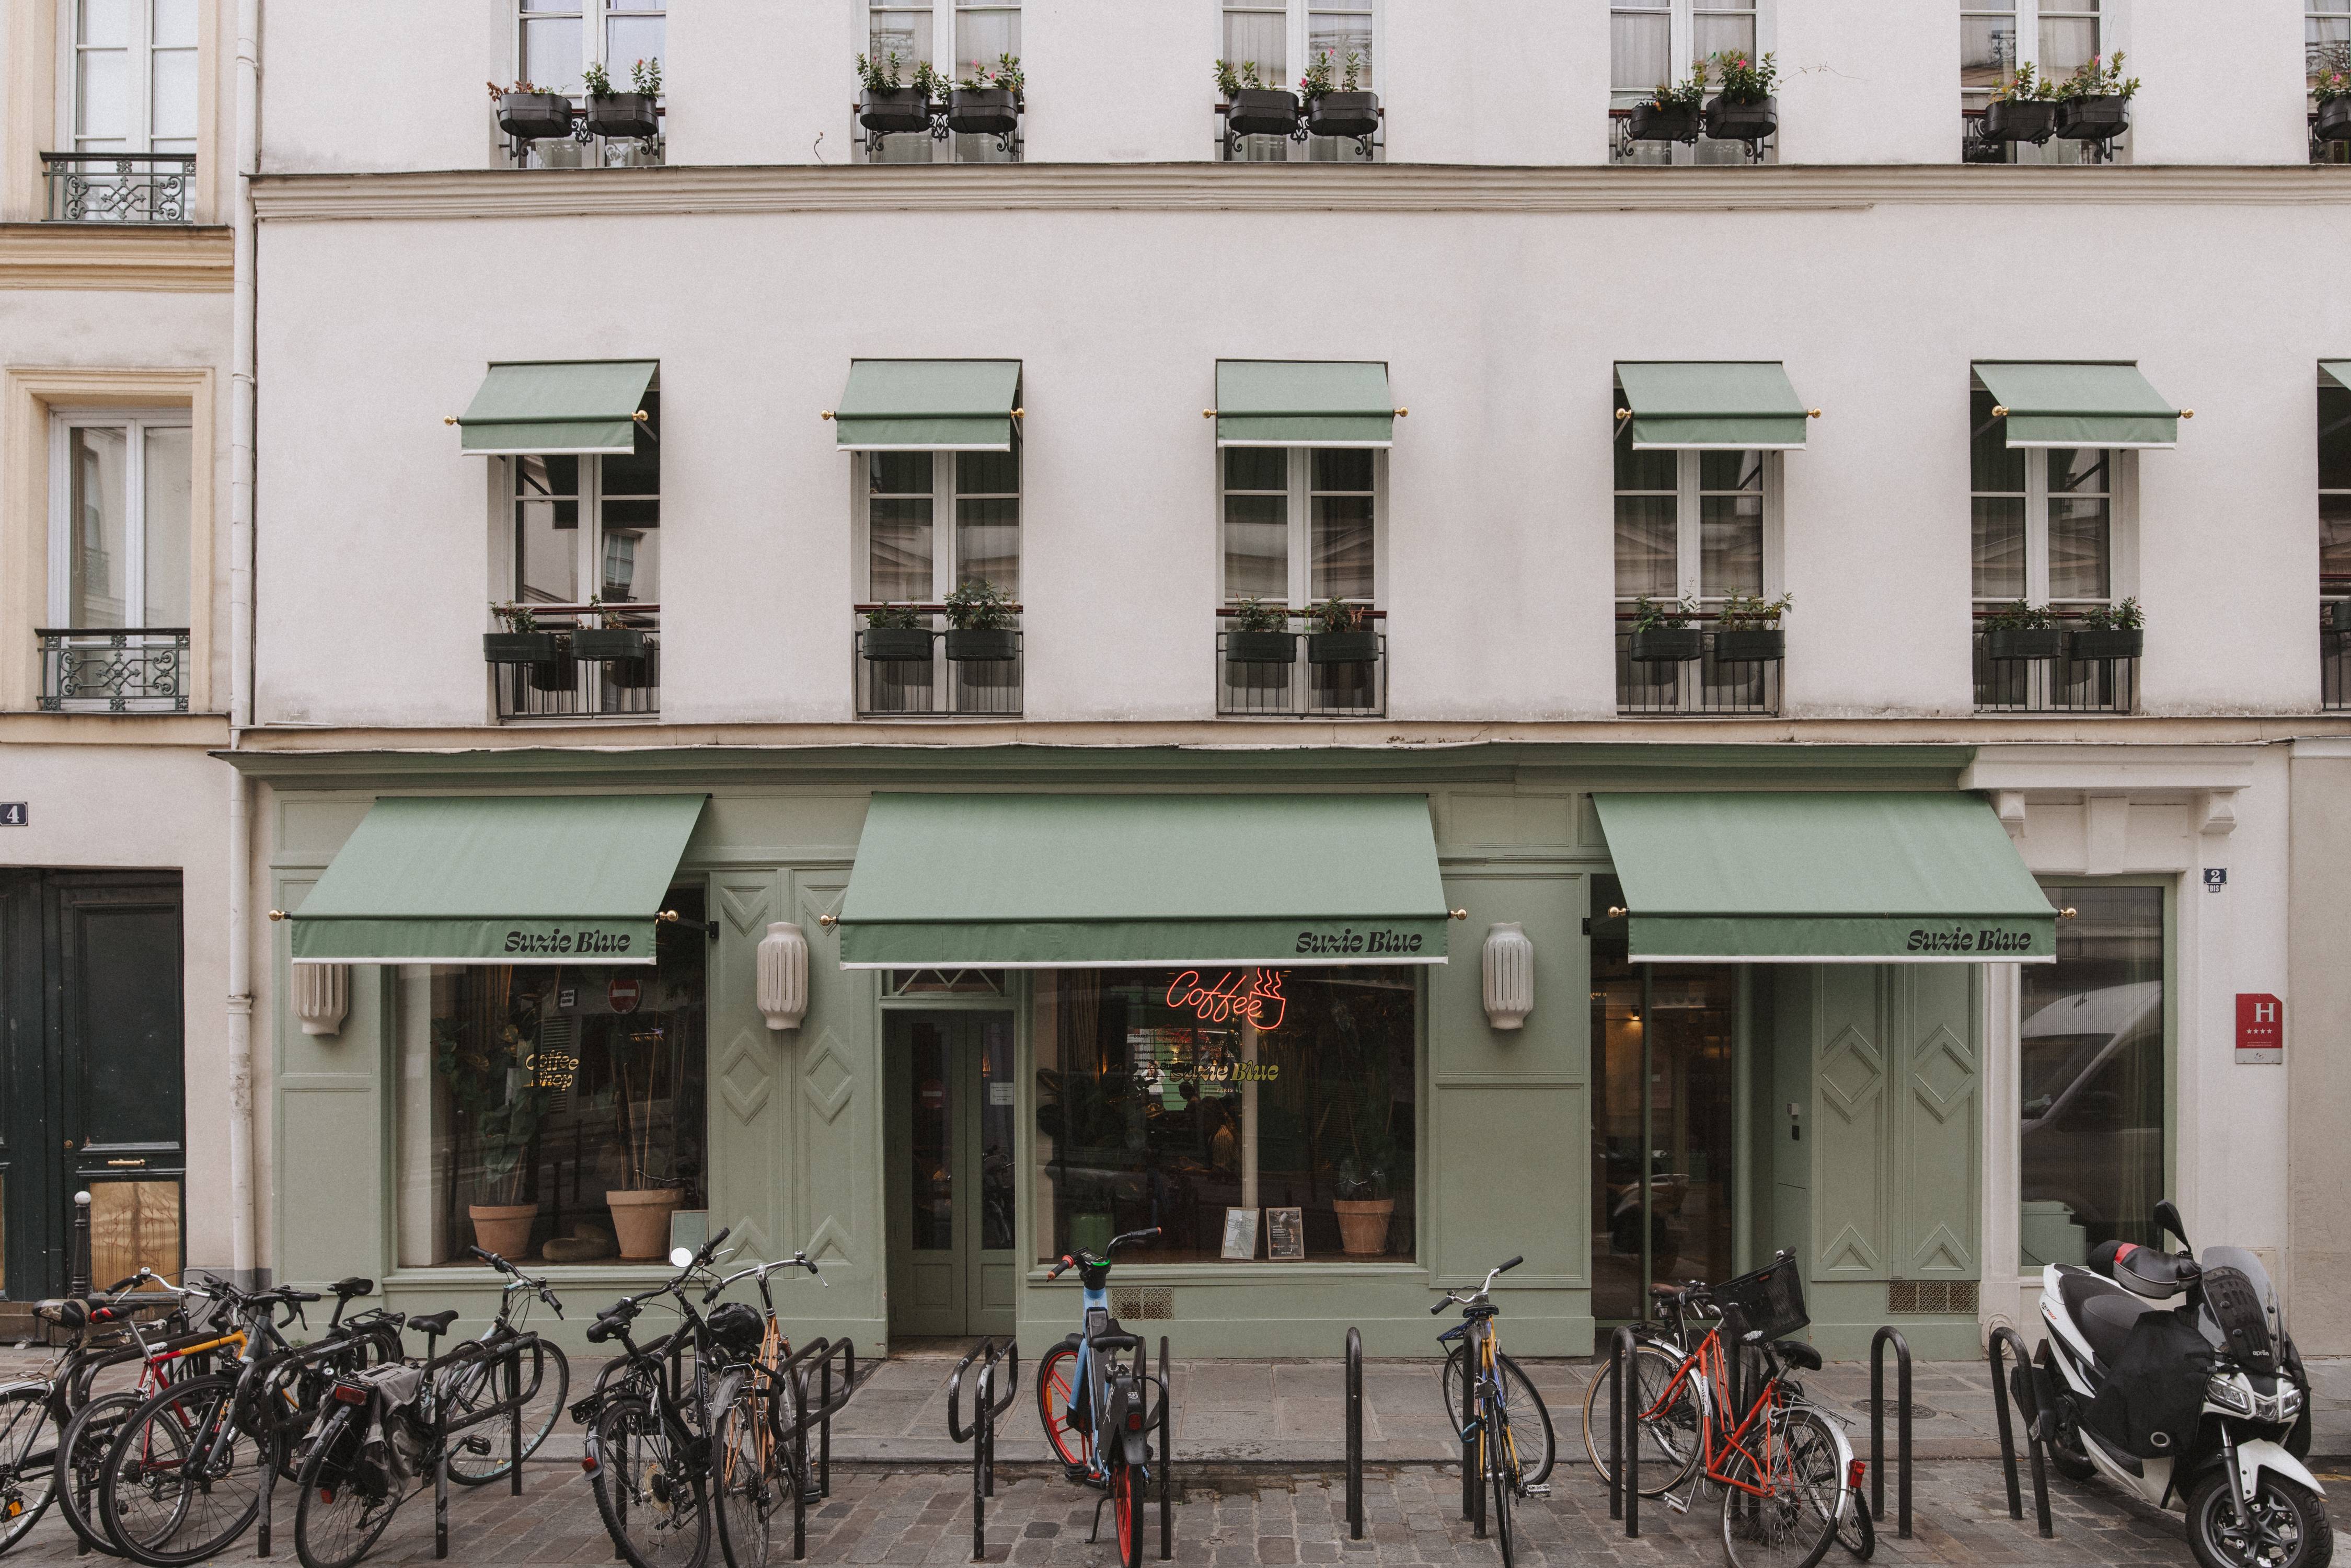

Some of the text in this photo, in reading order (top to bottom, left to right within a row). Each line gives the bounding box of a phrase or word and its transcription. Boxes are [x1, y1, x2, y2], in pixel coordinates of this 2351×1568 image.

[6, 805, 19, 823] 4
[2210, 870, 2220, 883] 2
[504, 928, 630, 953] Suzie Blue
[1295, 928, 1422, 953] Suzie Blue
[1907, 926, 2031, 951] Suzie Blue
[1167, 971, 1262, 1022] Coffee
[2254, 1002, 2276, 1022] H
[526, 1050, 579, 1070] Coffee
[1170, 1059, 1228, 1081] Suzie
[1230, 1060, 1279, 1081] Blue
